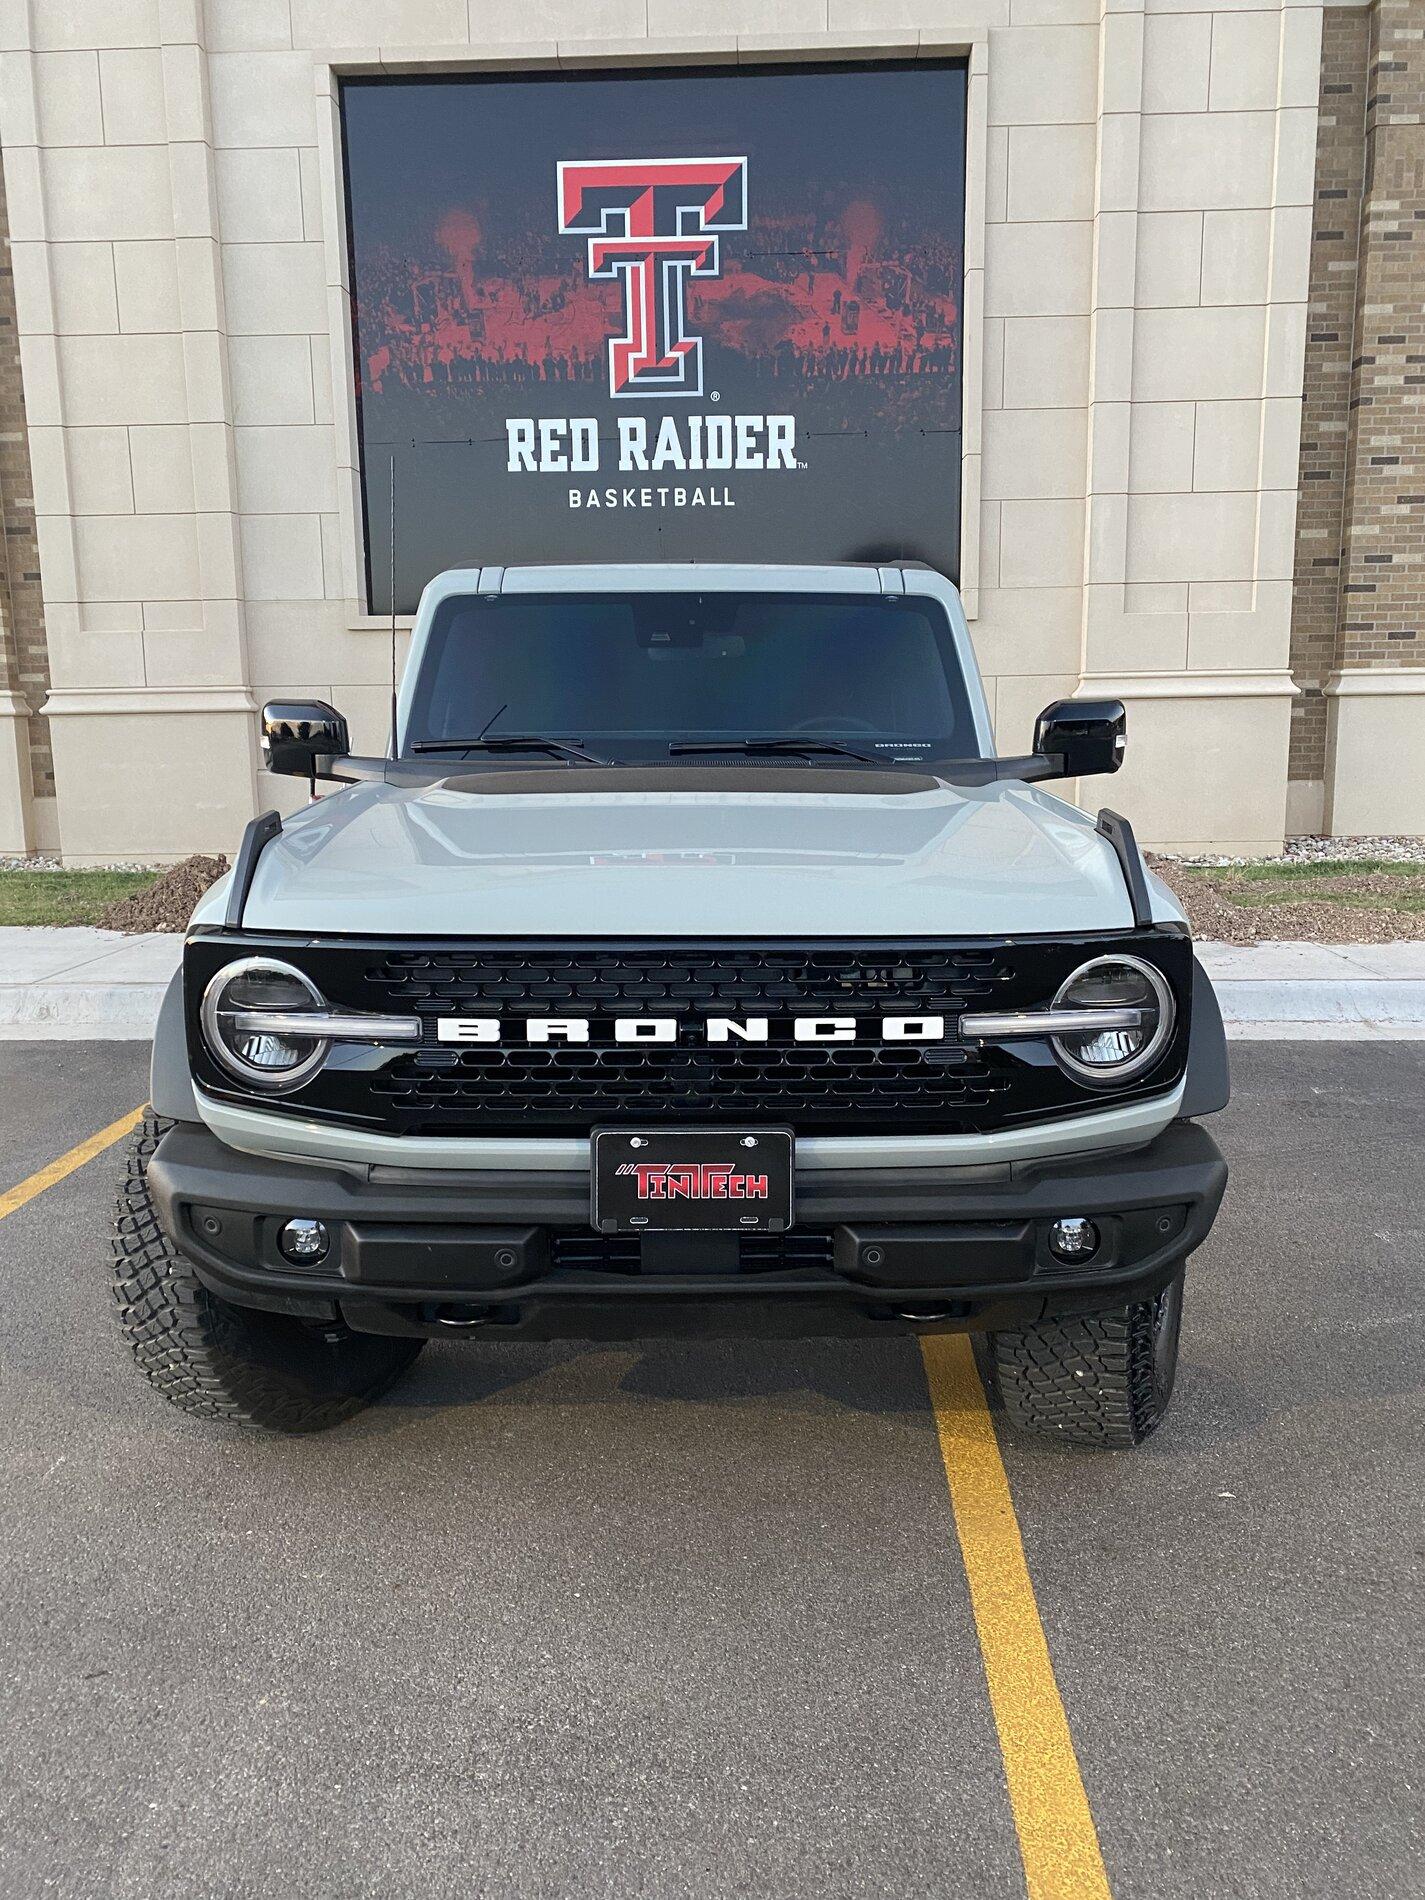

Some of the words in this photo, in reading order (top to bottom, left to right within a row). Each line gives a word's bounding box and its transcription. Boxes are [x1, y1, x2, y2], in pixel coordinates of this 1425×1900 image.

[505, 417, 599, 472] RED
[617, 415, 797, 471] RAIDER
[568, 487, 735, 508] BASKETBALL
[437, 1016, 945, 1043] BRONCO
